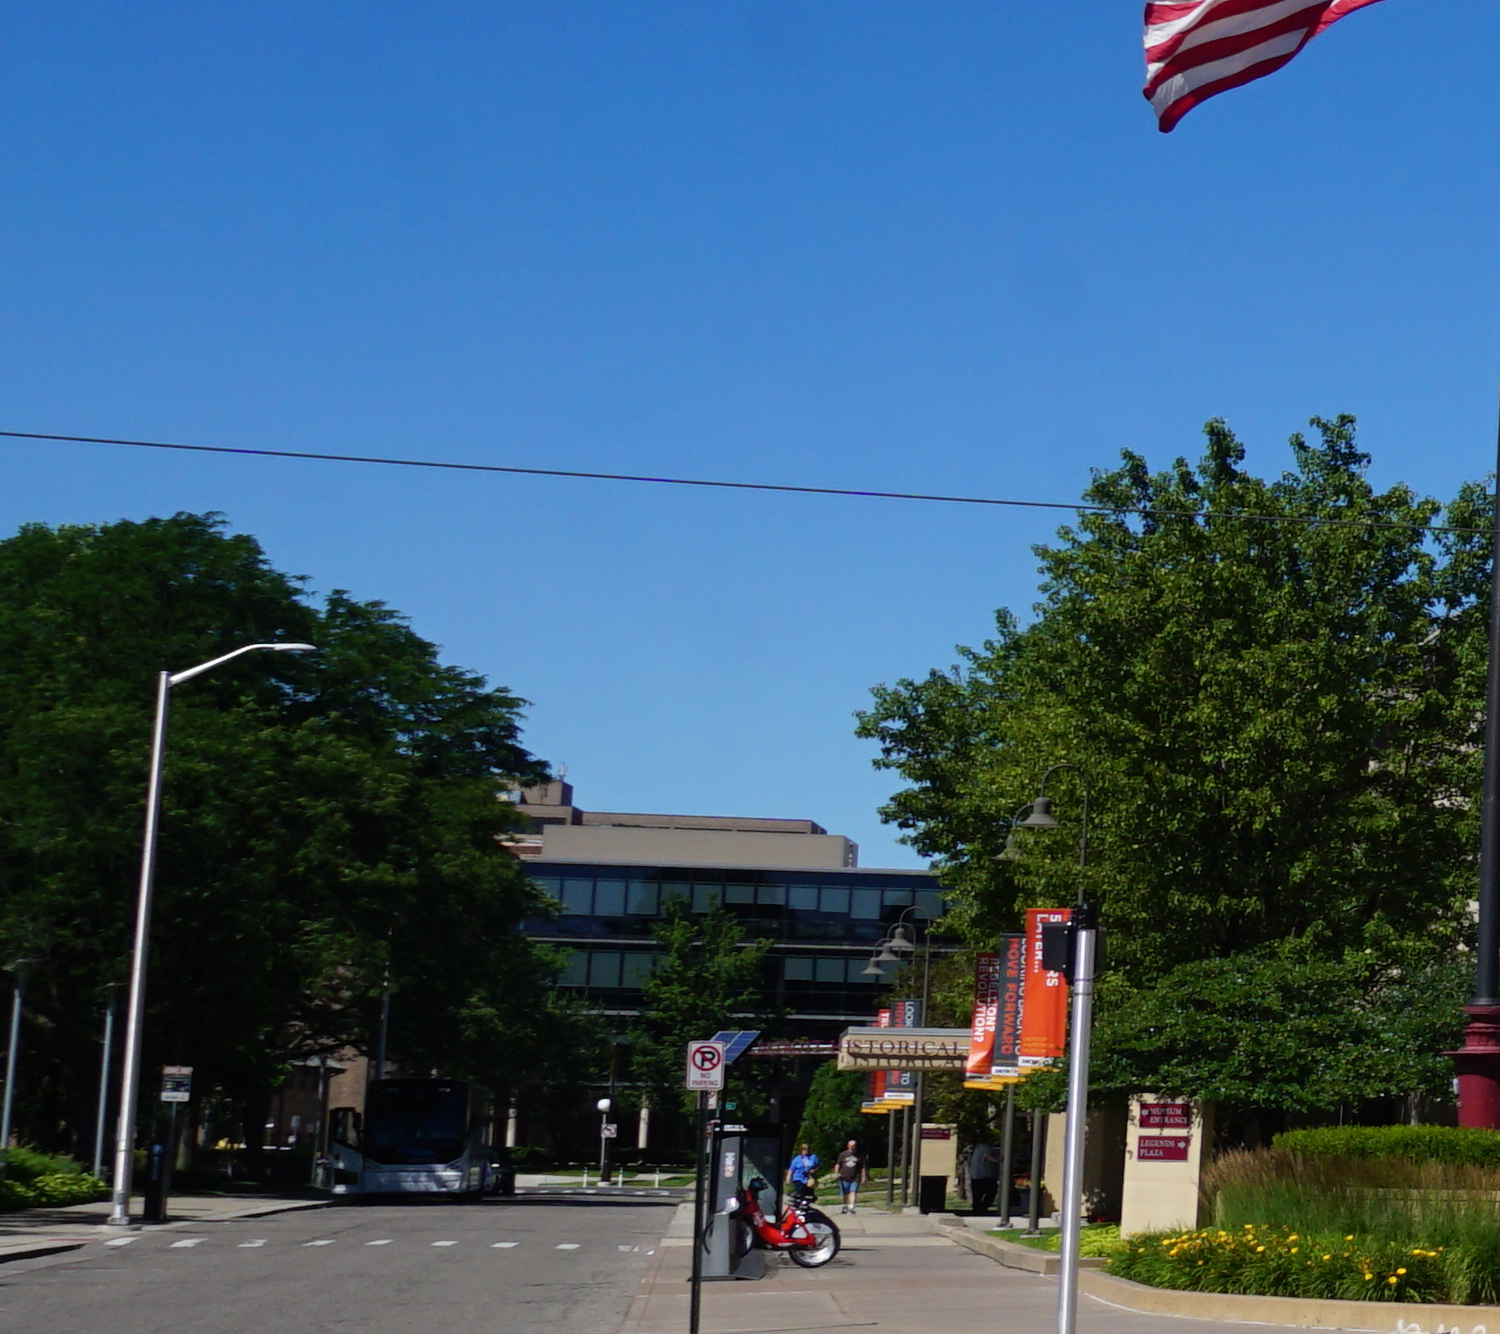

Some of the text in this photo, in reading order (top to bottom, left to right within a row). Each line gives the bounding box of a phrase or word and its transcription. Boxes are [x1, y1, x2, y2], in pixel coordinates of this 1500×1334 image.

[1006, 938, 1020, 977] MOVE
[973, 957, 989, 1043] REVOLUTION?
[1001, 983, 1018, 1055] FORWARD
[1140, 1149, 1163, 1157] PLAZA
